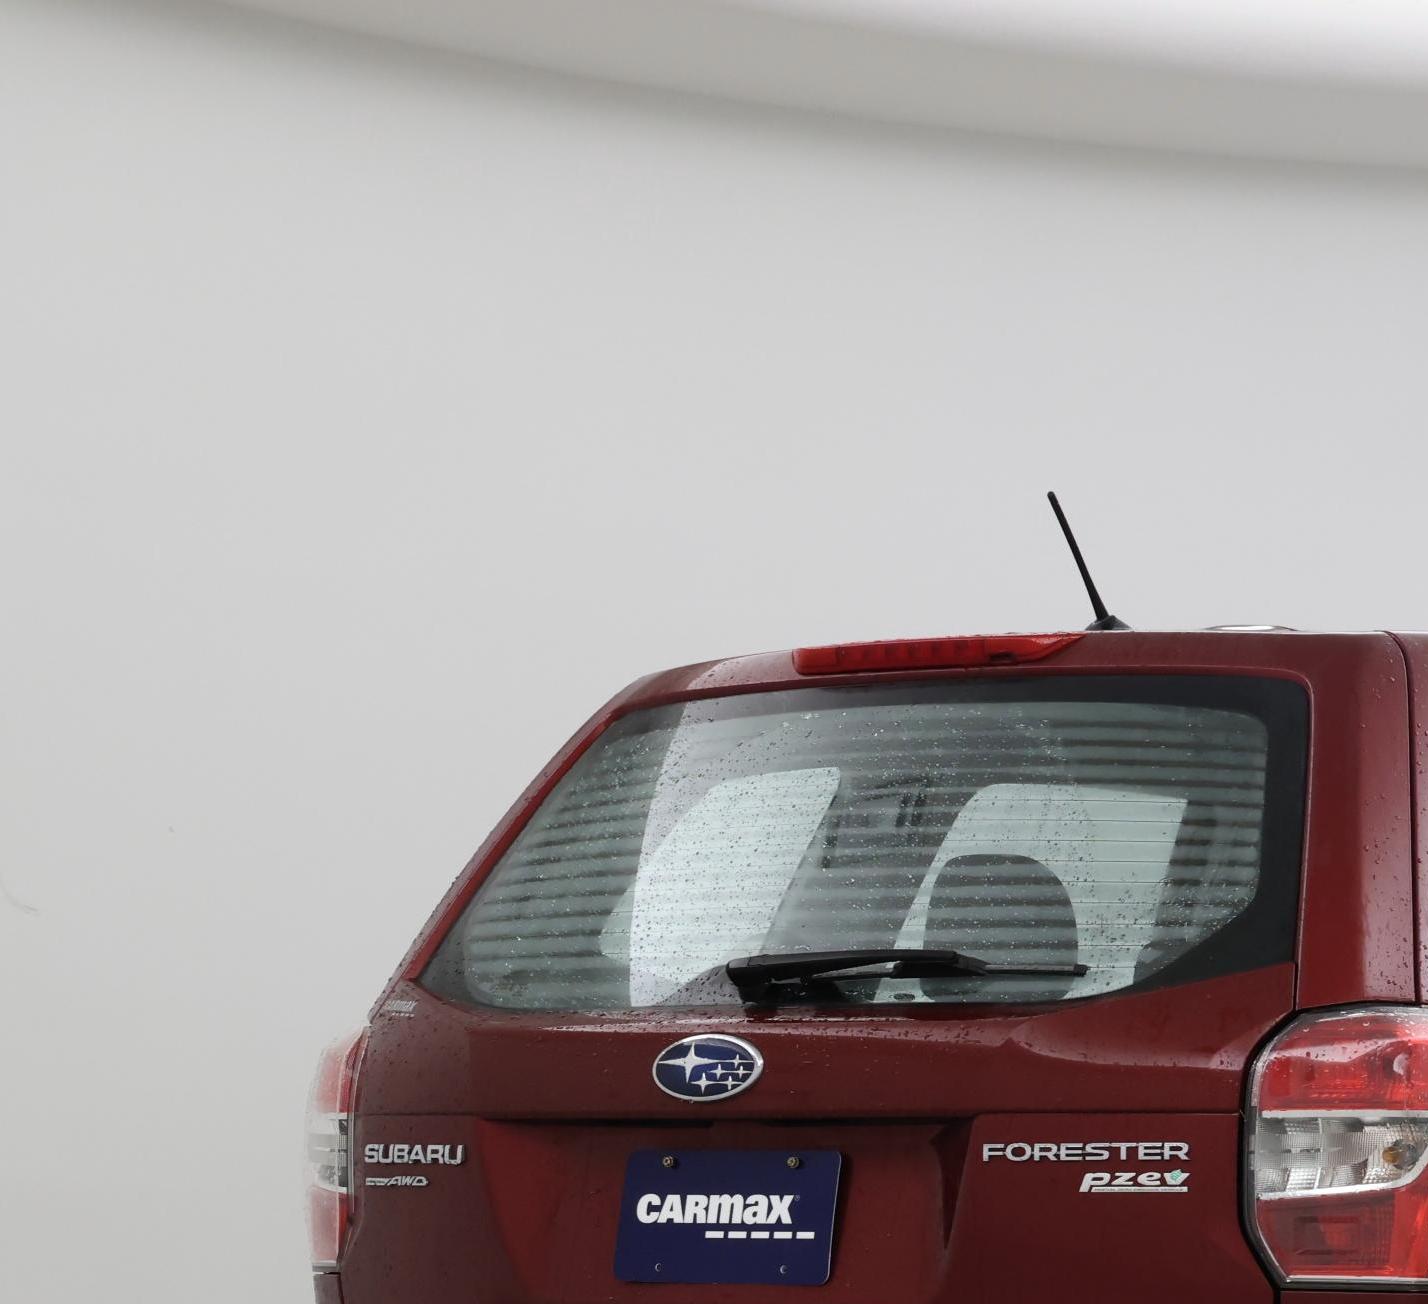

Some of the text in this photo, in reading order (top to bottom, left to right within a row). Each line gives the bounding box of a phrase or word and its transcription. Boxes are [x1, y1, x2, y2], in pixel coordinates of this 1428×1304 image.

[364, 1143, 464, 1165] SUBARU
[982, 1142, 1190, 1161] FORESTER
[387, 1175, 428, 1186] AWD
